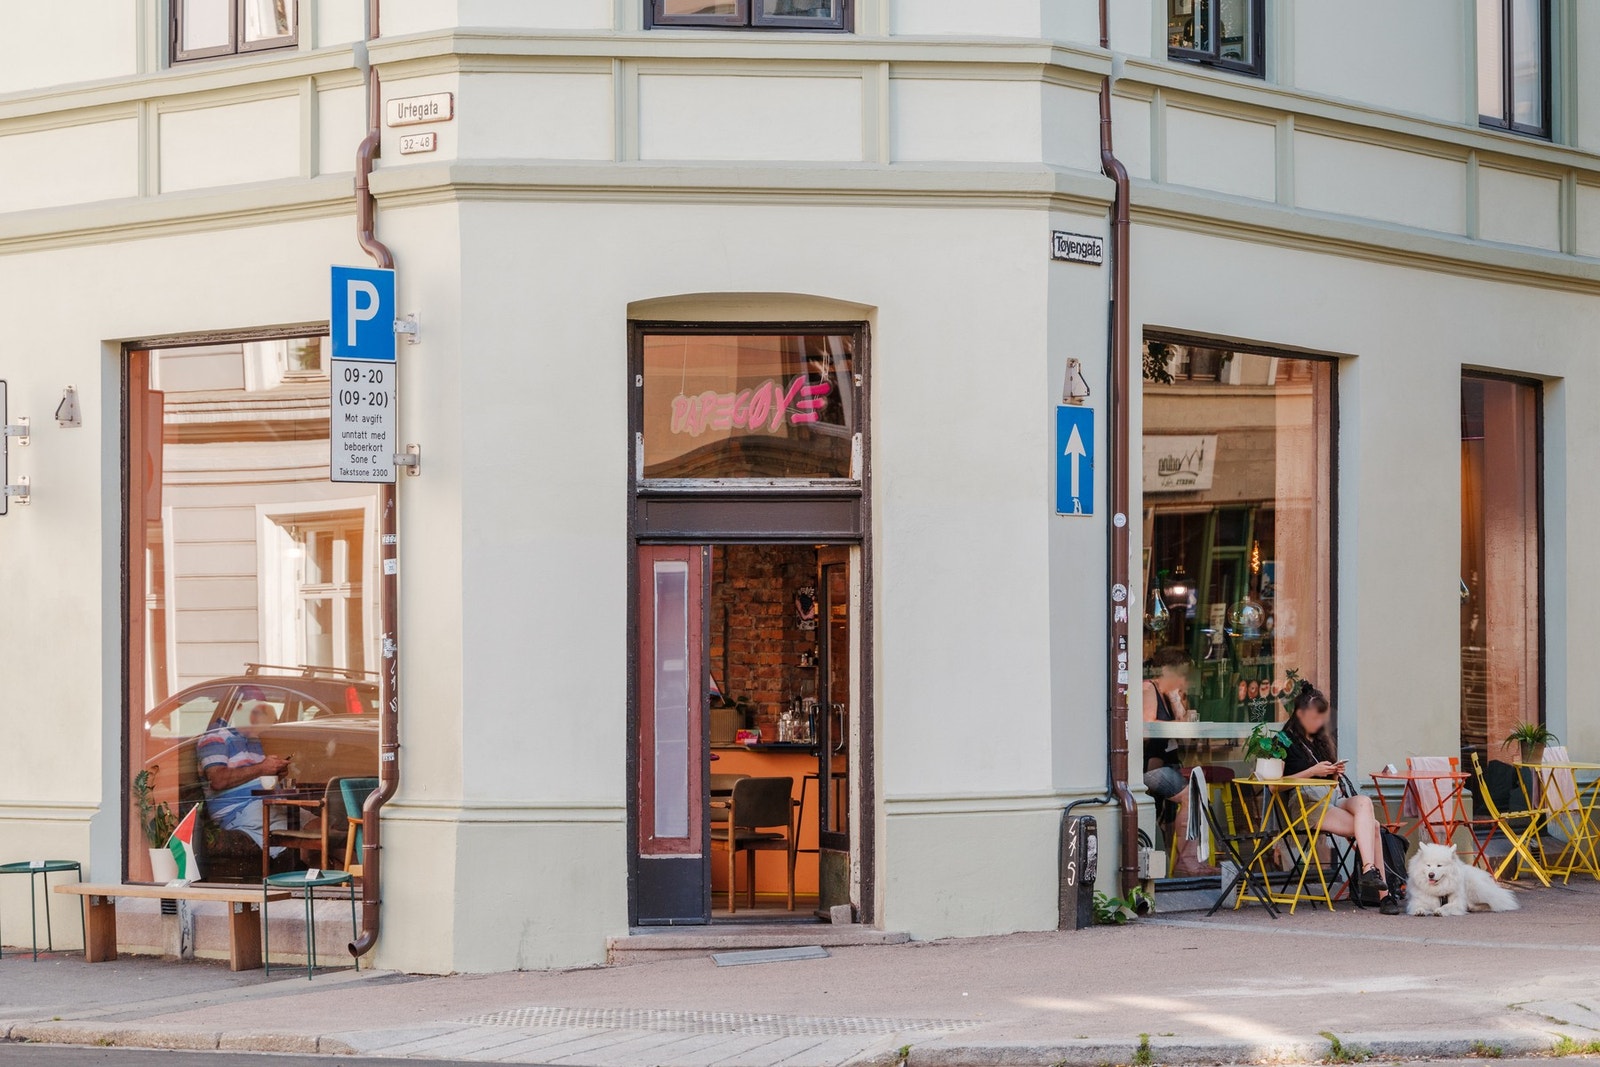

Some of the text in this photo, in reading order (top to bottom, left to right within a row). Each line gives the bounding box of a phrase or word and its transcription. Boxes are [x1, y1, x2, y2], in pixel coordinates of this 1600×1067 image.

[397, 100, 439, 120] Urtegata
[404, 136, 430, 150] 32-48
[1055, 235, 1102, 259] Tøyengata
[347, 279, 380, 347] P
[344, 367, 383, 384] 09-20
[339, 390, 389, 408] (09-20)
[673, 374, 833, 435] PAPEGØYE
[344, 412, 383, 425] Mot avgift
[341, 429, 386, 441] unntatt med
[343, 441, 383, 452] beboerkort
[350, 454, 377, 465] Sone C
[339, 467, 388, 477] Takstsone 2300
